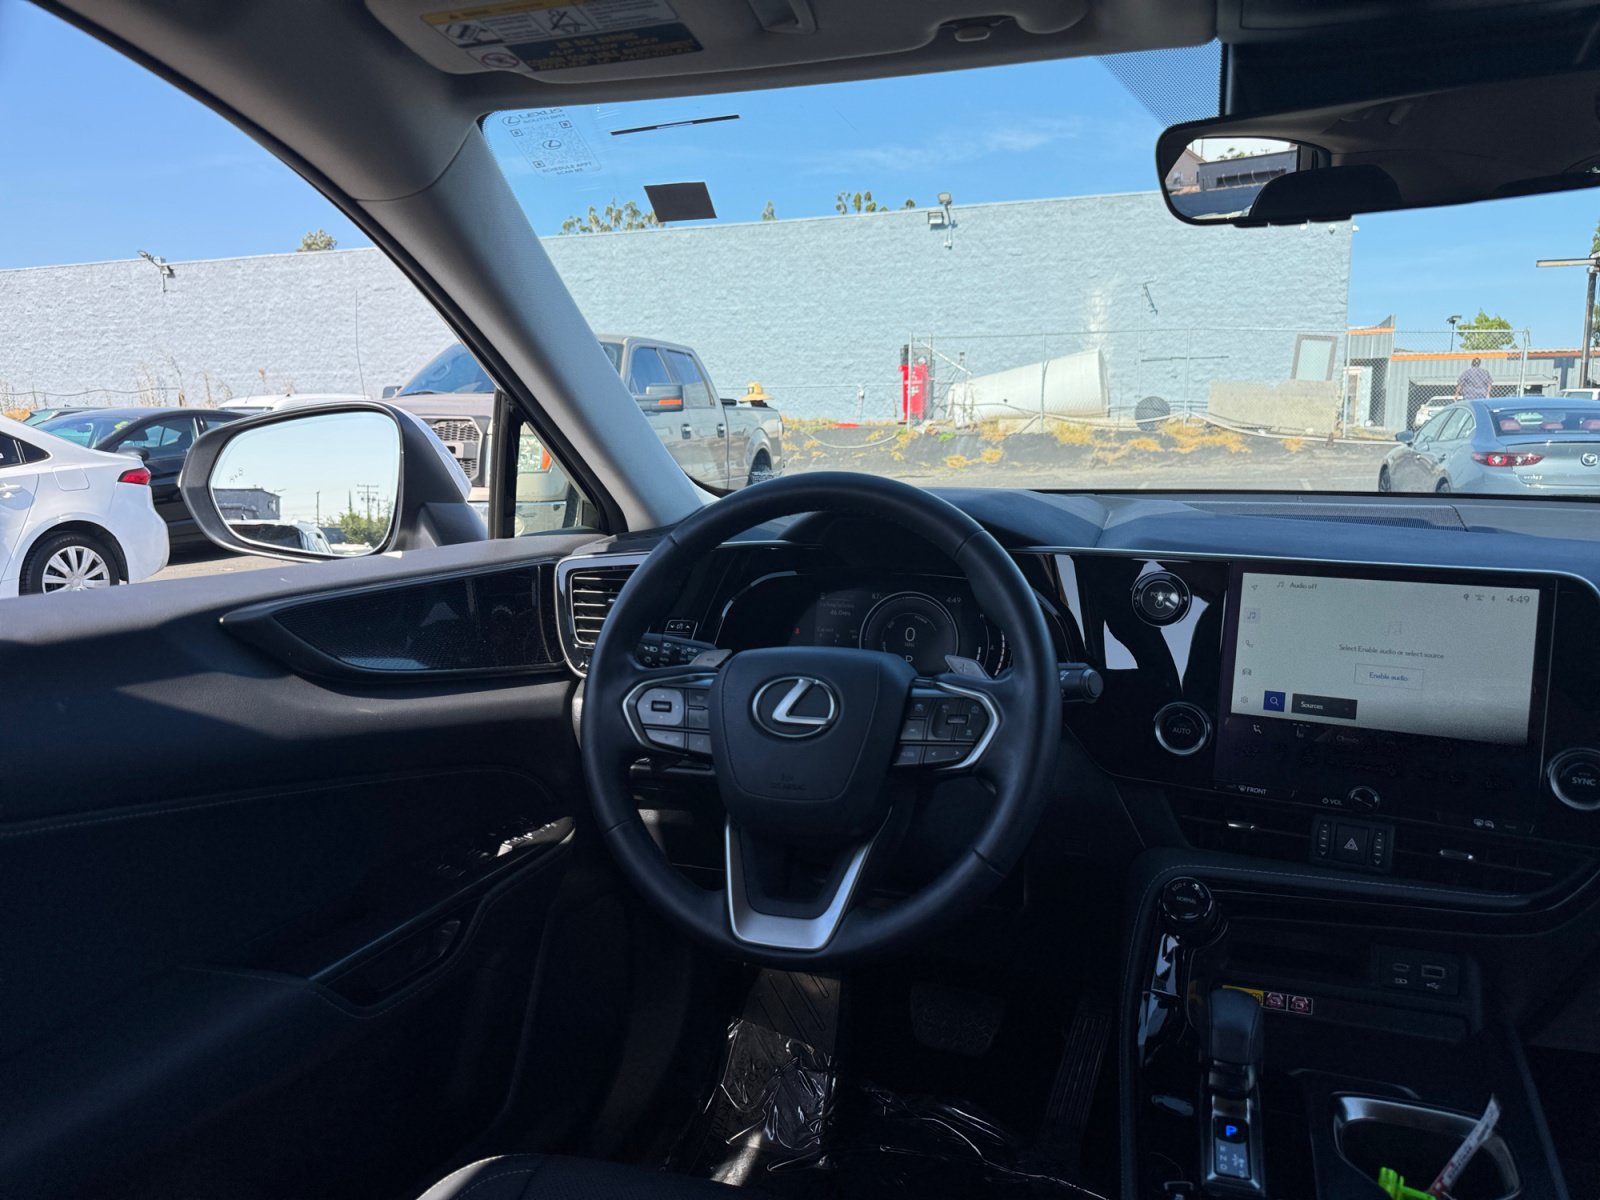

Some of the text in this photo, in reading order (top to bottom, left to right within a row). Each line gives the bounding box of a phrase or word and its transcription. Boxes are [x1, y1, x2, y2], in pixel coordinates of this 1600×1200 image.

[519, 108, 563, 119] LEXUS
[1506, 595, 1530, 604] 4:49
[904, 627, 916, 642] 0
[1339, 643, 1357, 652] Select
[1358, 645, 1378, 653] Enable
[1369, 671, 1390, 680] Enable
[1300, 701, 1324, 710] Sources
[1172, 727, 1191, 735] AUTO
[1571, 776, 1596, 786] SYNC
[1246, 786, 1267, 795] FRONT
[1330, 798, 1343, 806] VOL
[1225, 1124, 1238, 1137] P
